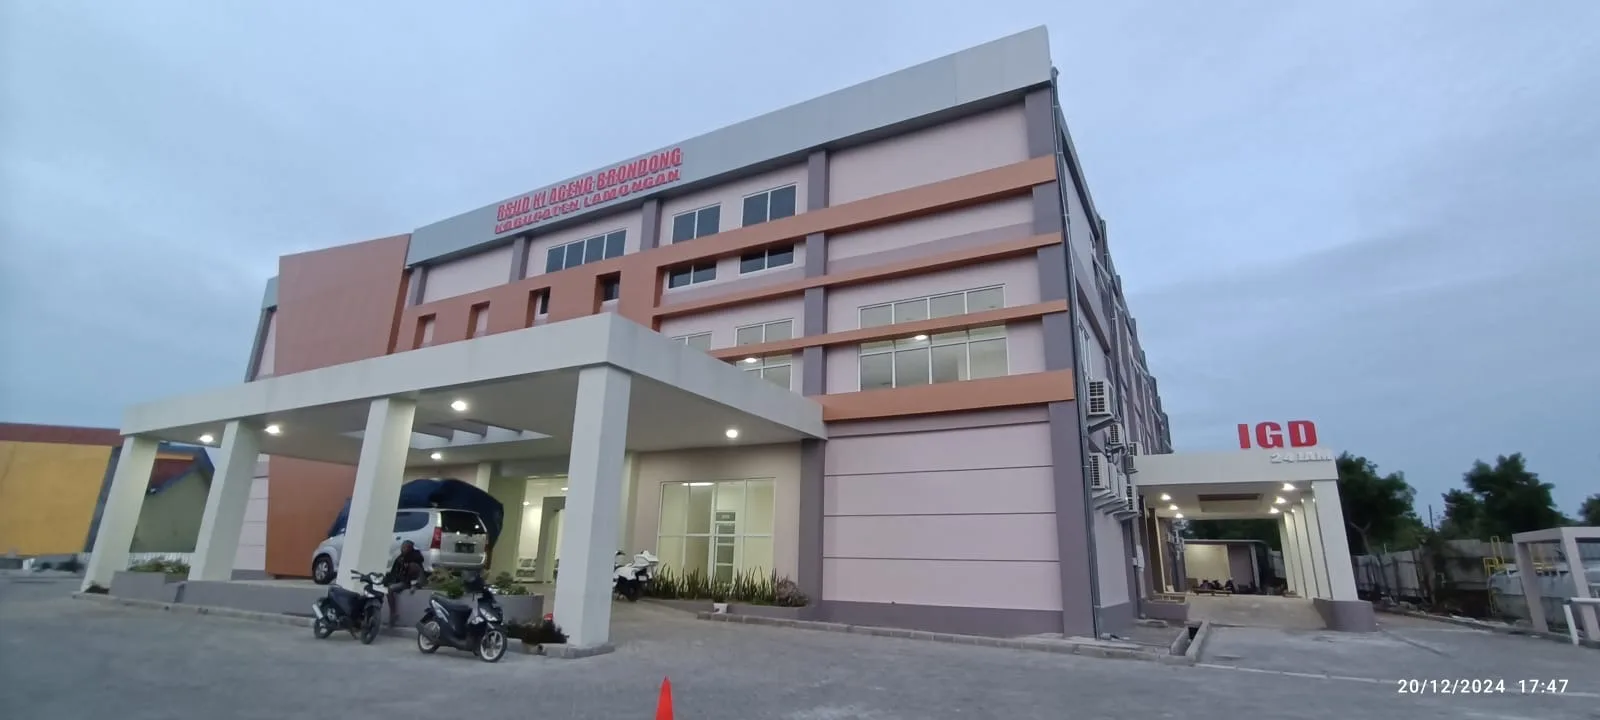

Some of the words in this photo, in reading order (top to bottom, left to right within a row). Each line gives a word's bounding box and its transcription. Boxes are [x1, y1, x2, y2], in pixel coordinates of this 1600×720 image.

[495, 200, 580, 234] KABUPATEN
[583, 169, 681, 207] LAMONGAN
[497, 195, 531, 222] RSUD
[533, 190, 548, 209] KI
[549, 175, 594, 204] AGENG
[596, 147, 682, 189] BRONDONG
[1237, 420, 1318, 449] IGD
